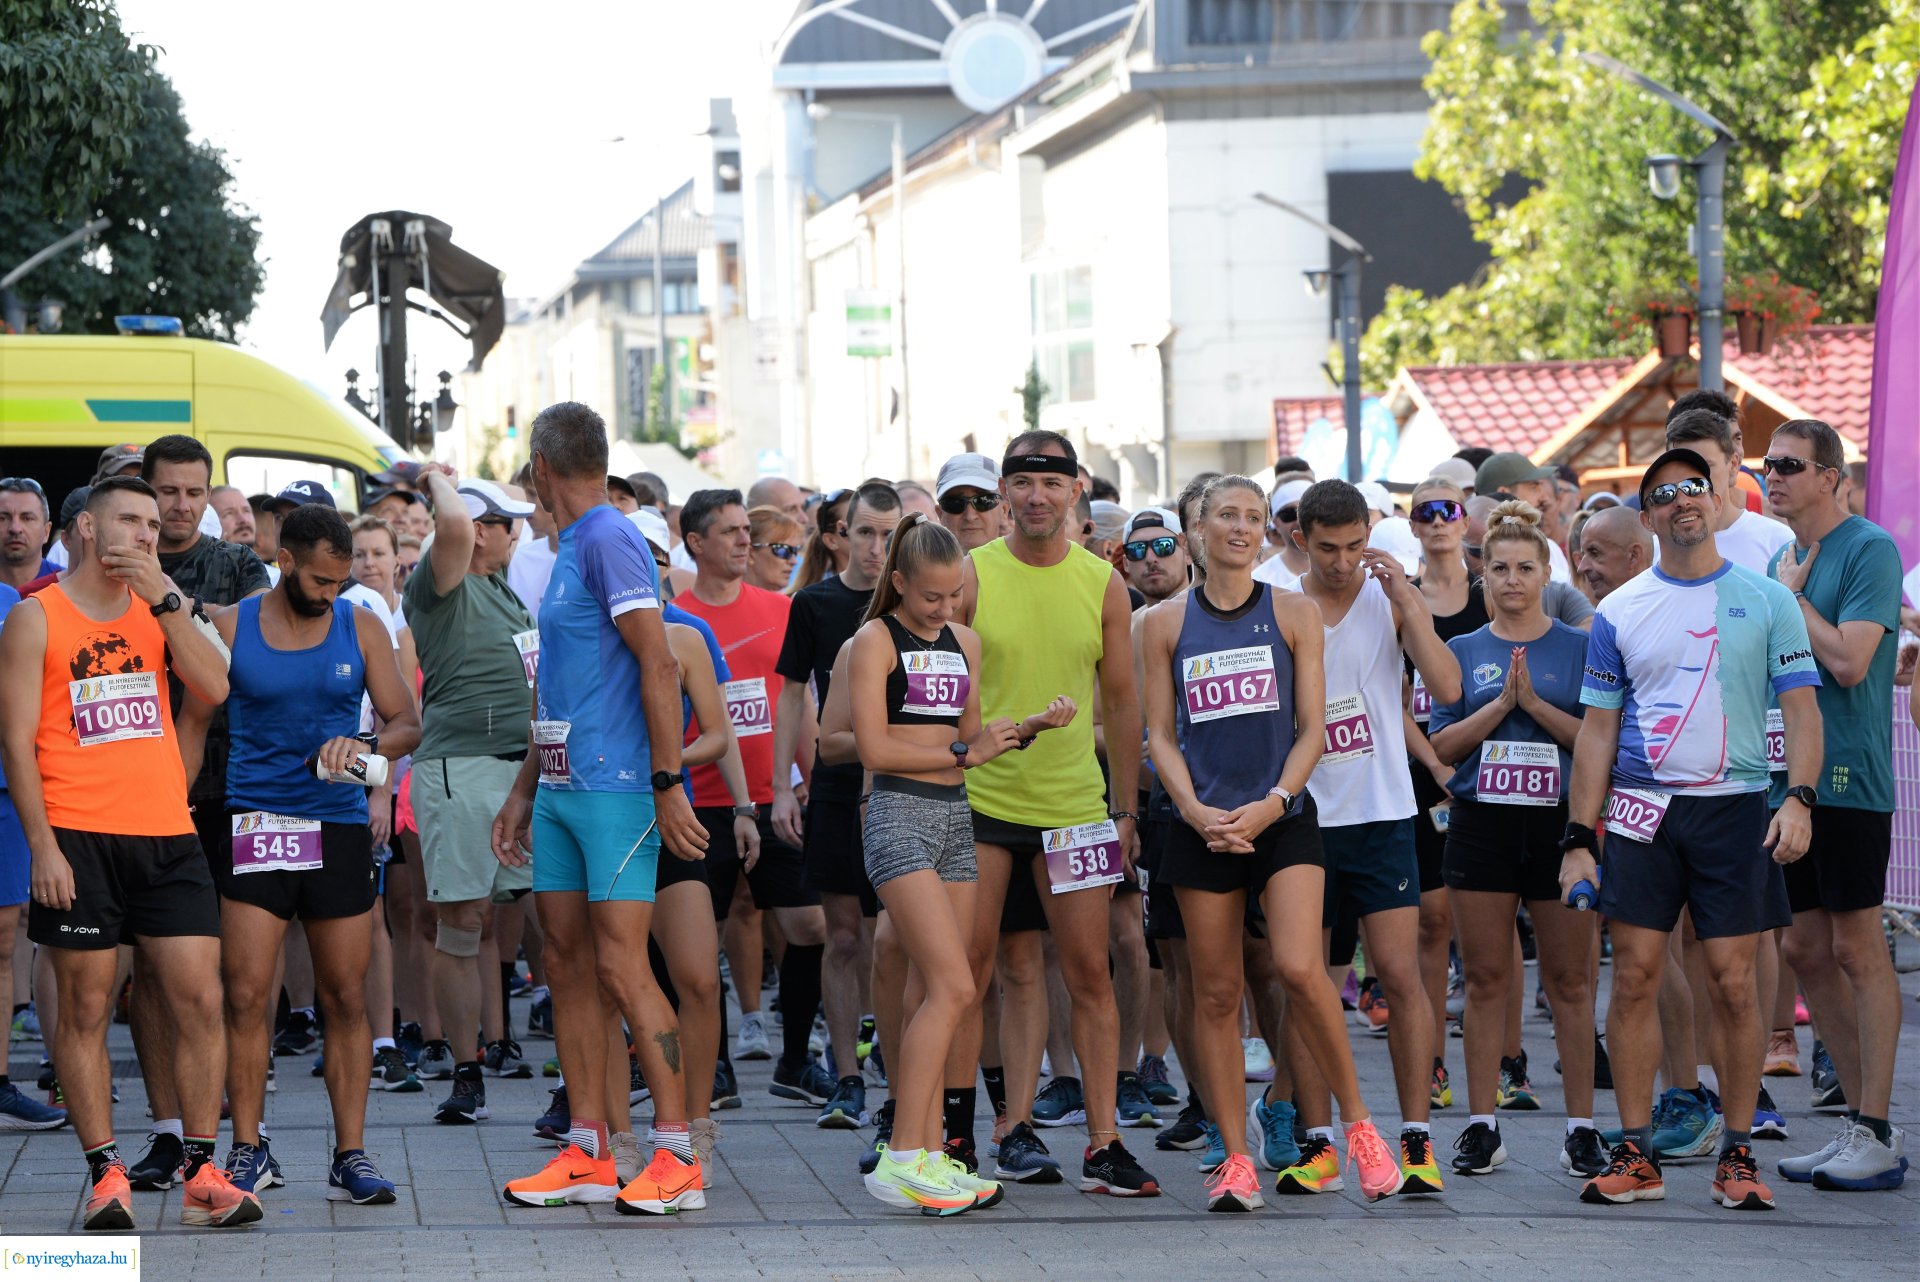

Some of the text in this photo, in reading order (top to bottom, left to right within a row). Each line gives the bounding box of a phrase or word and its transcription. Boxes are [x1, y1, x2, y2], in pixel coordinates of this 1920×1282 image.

[925, 677, 959, 702] 557
[1190, 673, 1272, 708] 10167
[79, 700, 157, 732] 10009
[729, 699, 766, 723] 207
[1767, 736, 1785, 758] 03
[1483, 767, 1555, 793] 10181
[253, 835, 300, 858] 545
[1068, 846, 1109, 876] 538
